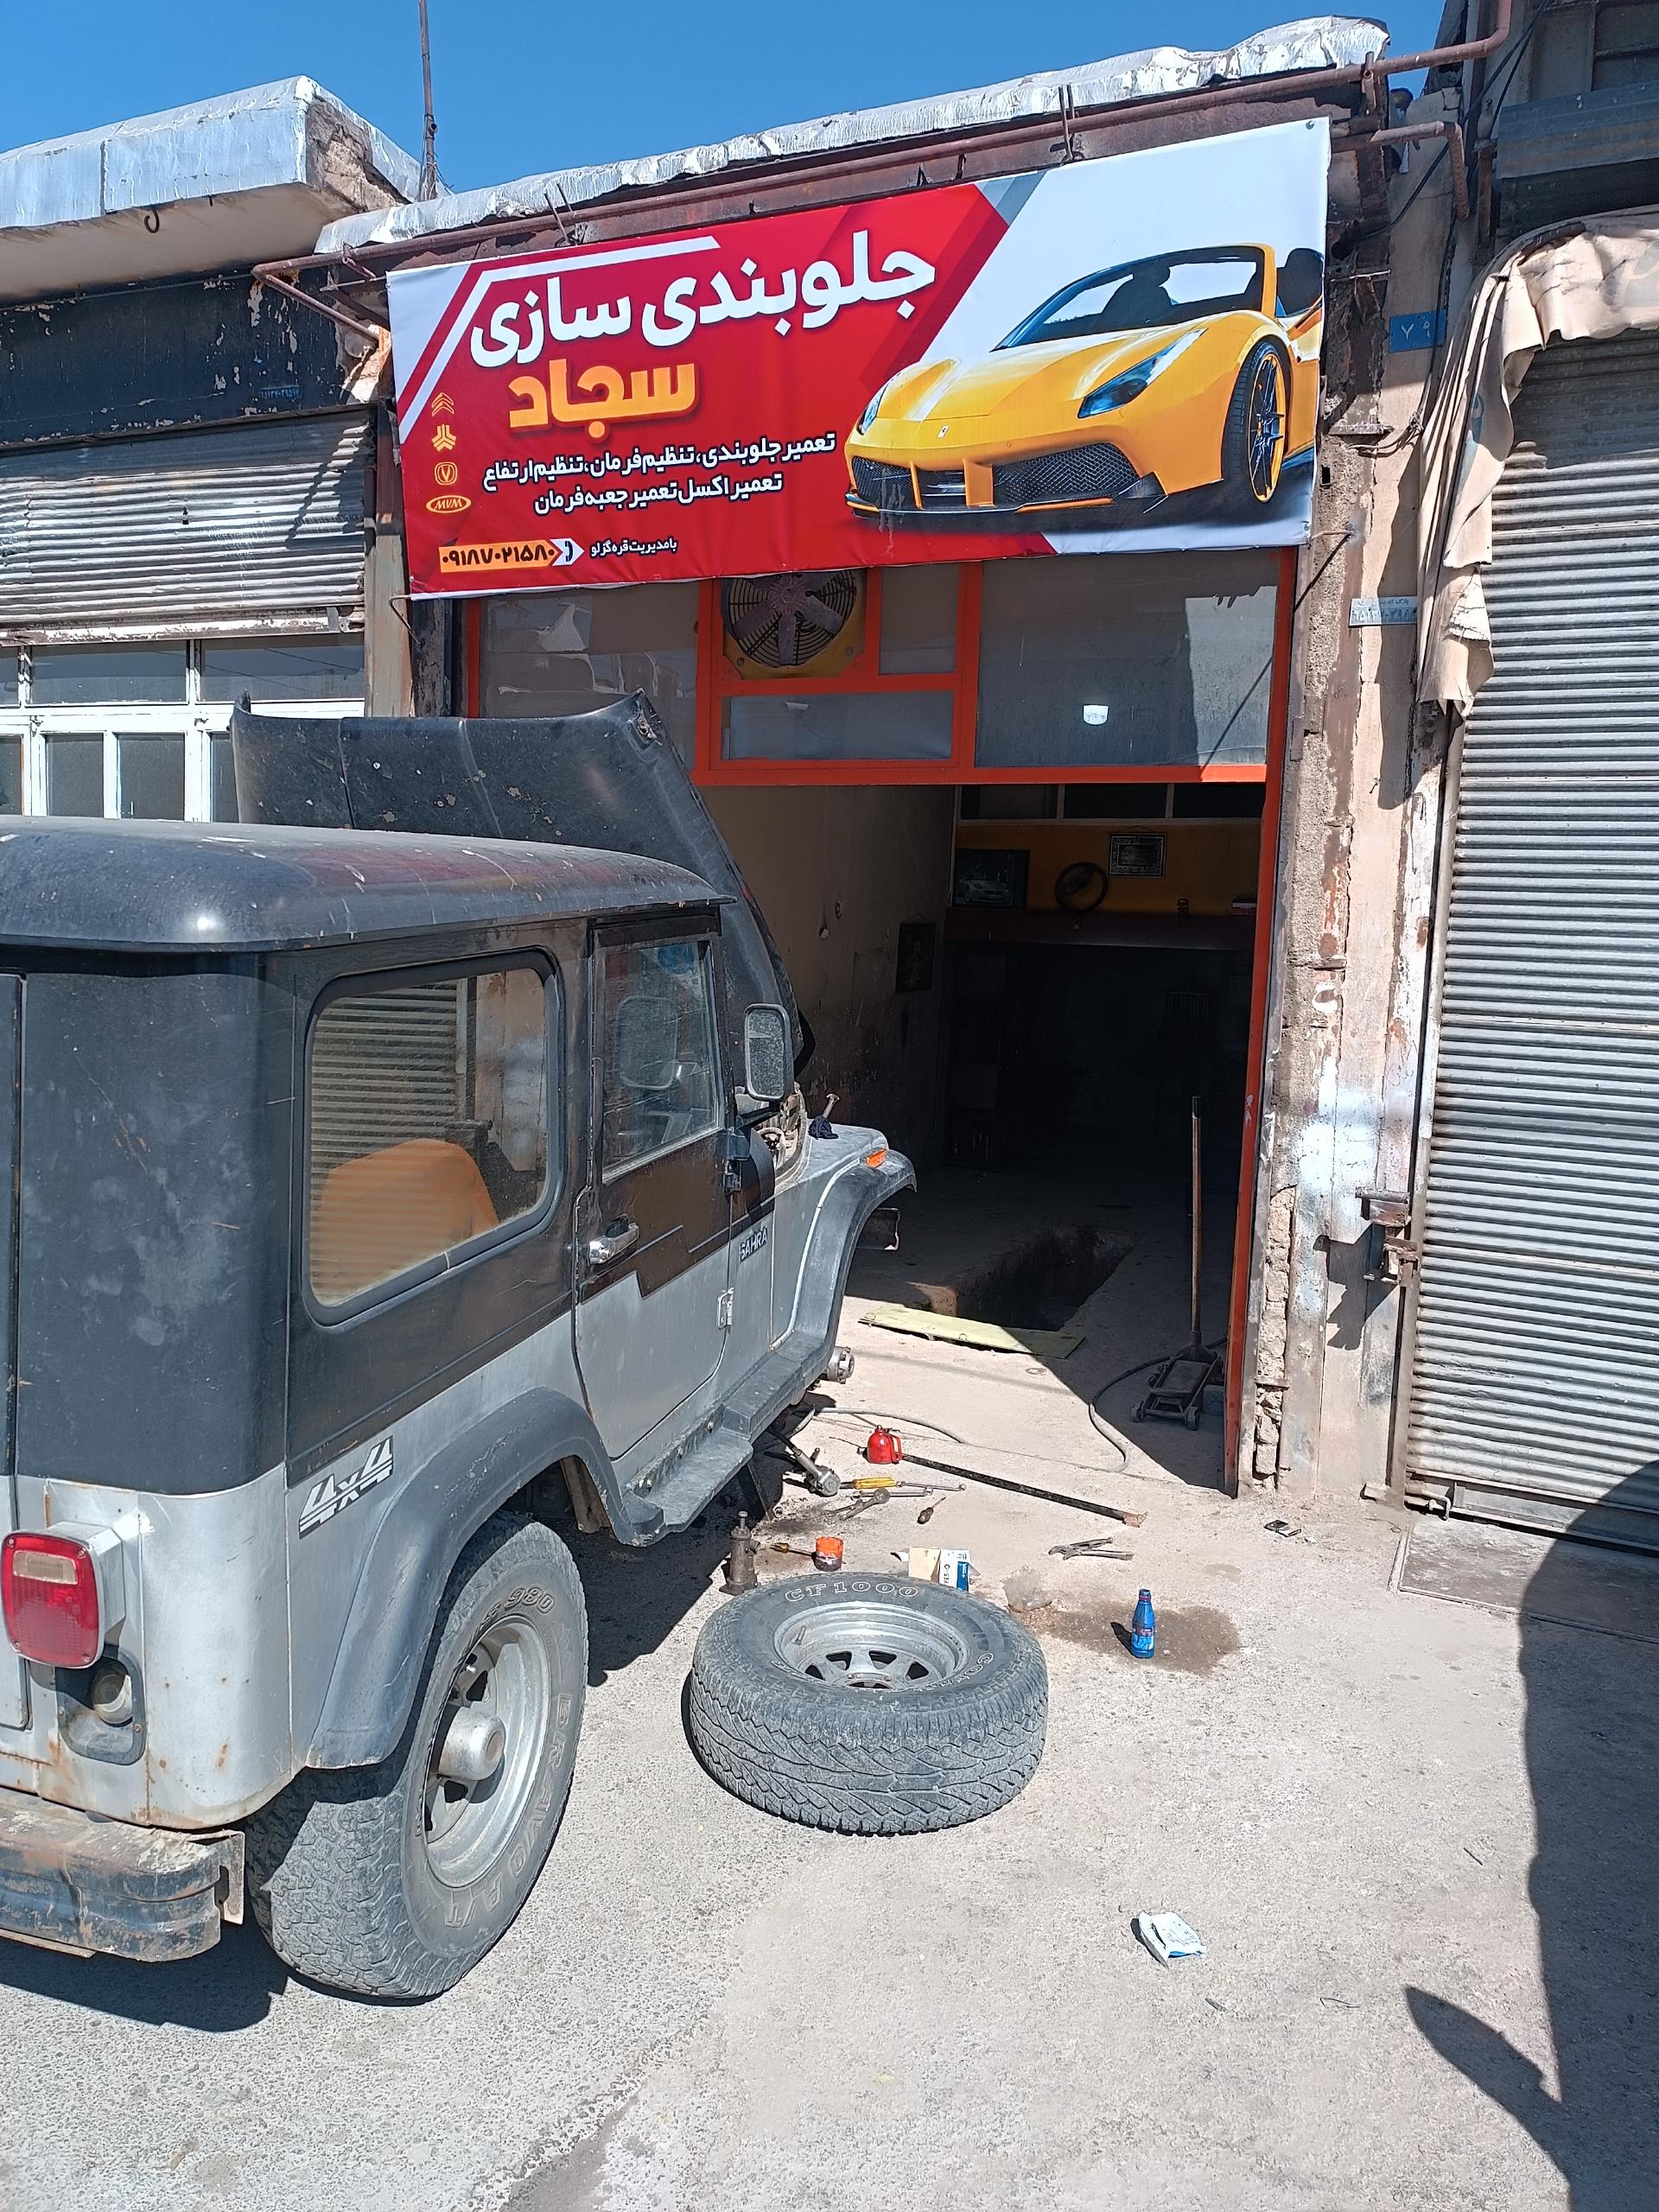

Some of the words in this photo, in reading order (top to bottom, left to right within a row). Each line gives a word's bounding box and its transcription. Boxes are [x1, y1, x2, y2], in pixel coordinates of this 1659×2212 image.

[641, 230, 935, 346] جلوبندی
[470, 276, 632, 368] سازی
[508, 358, 696, 439] سجاد
[781, 433, 836, 462] تعمیر
[729, 473, 783, 500] تعمیر
[434, 498, 463, 511] MVM
[442, 544, 556, 566] ۰۹۱۸۷۰۲۱۵۸۰
[503, 1586, 555, 1616] 980
